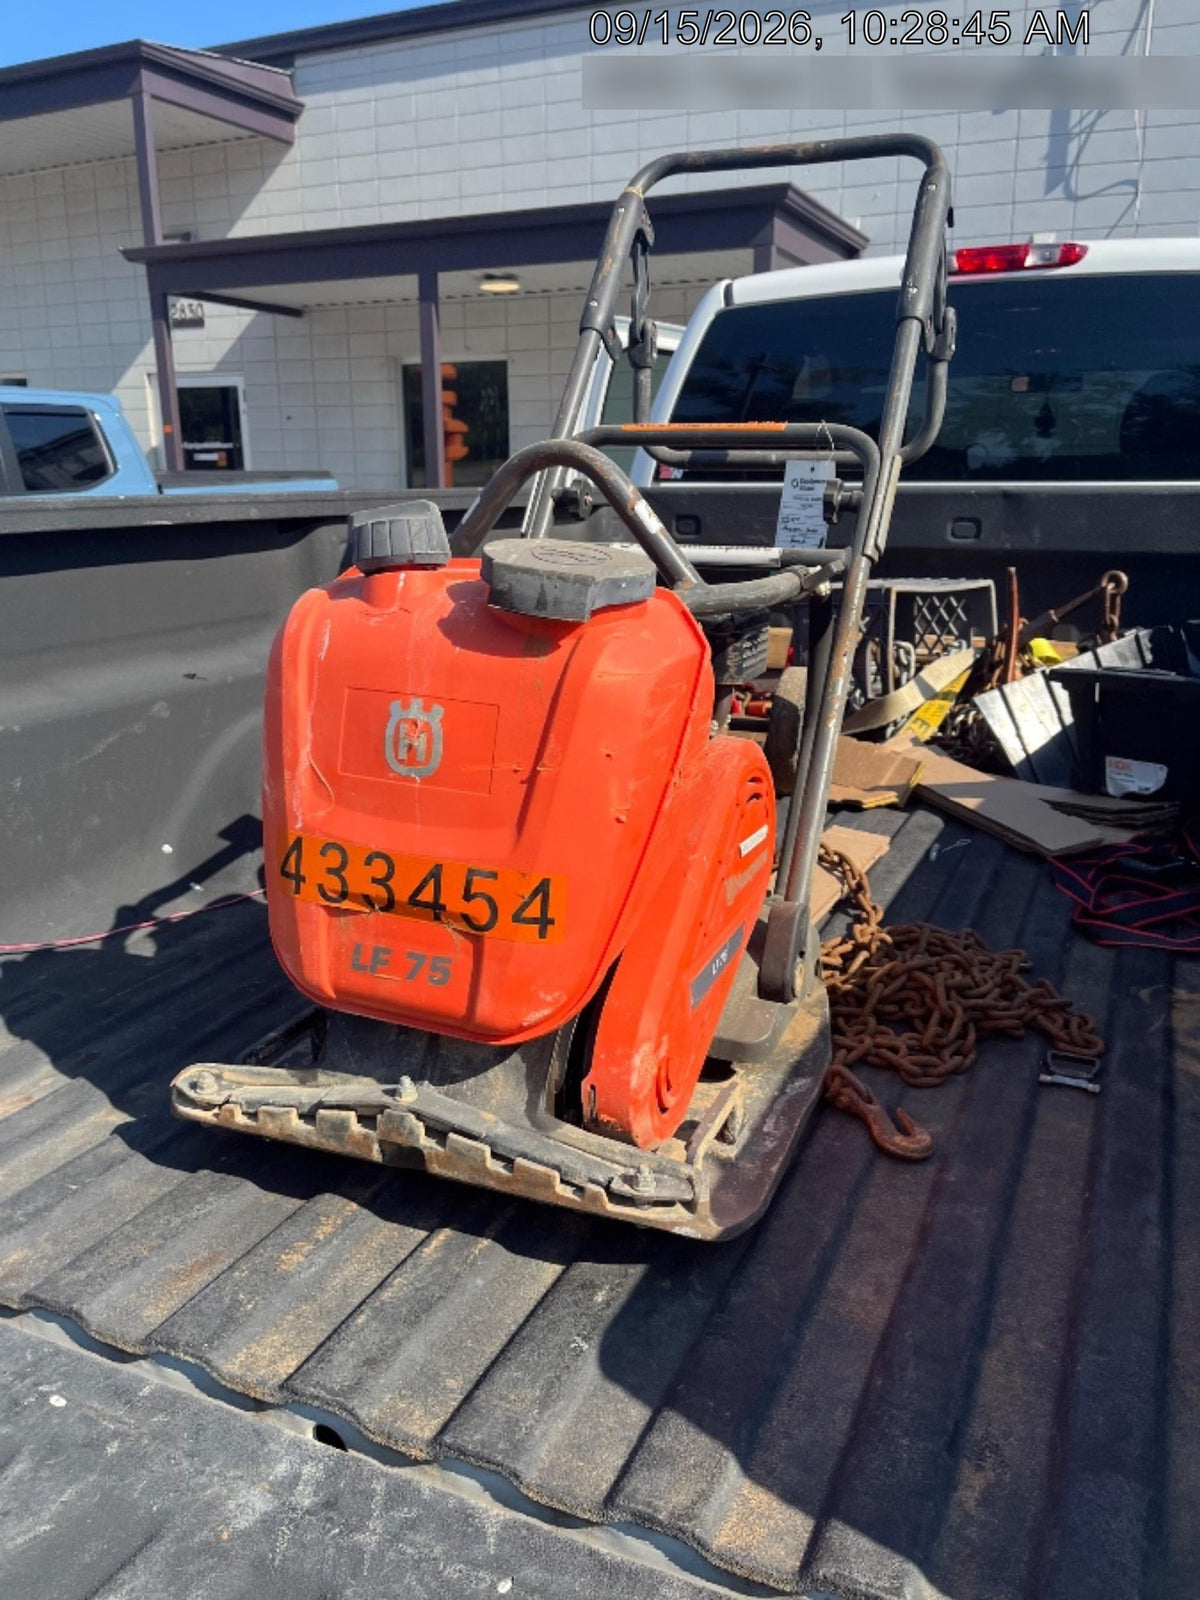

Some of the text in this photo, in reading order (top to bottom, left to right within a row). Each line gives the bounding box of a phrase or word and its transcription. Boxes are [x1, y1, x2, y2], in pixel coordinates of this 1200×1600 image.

[280, 836, 556, 940] 433454
[351, 942, 453, 987] LF 75
